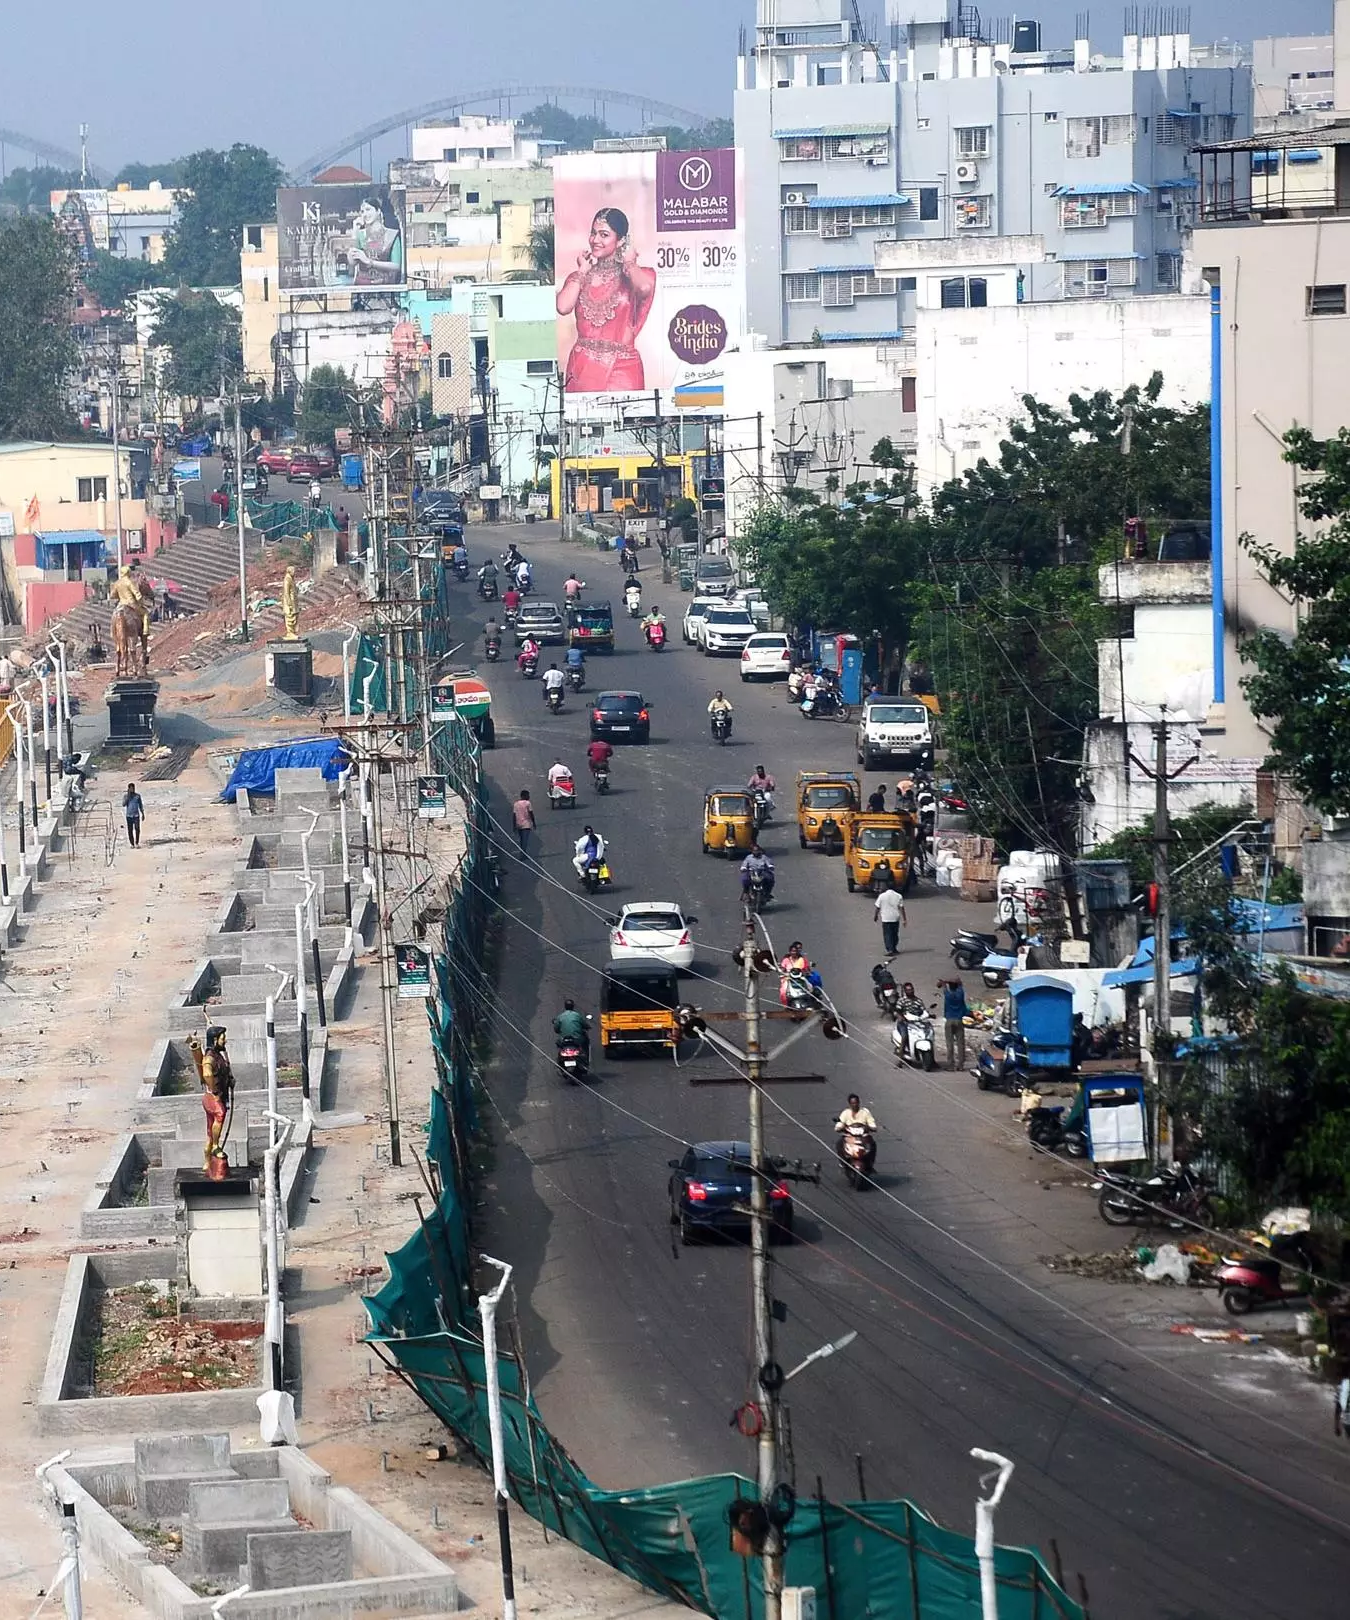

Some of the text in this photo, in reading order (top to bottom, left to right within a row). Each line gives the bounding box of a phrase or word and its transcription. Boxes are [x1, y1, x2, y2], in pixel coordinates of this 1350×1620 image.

[301, 201, 321, 224] Kj
[663, 196, 728, 209] MALABAR
[657, 247, 690, 268] 30%
[702, 246, 736, 268] 30%
[674, 317, 722, 336] Brides
[674, 334, 718, 355] of India
